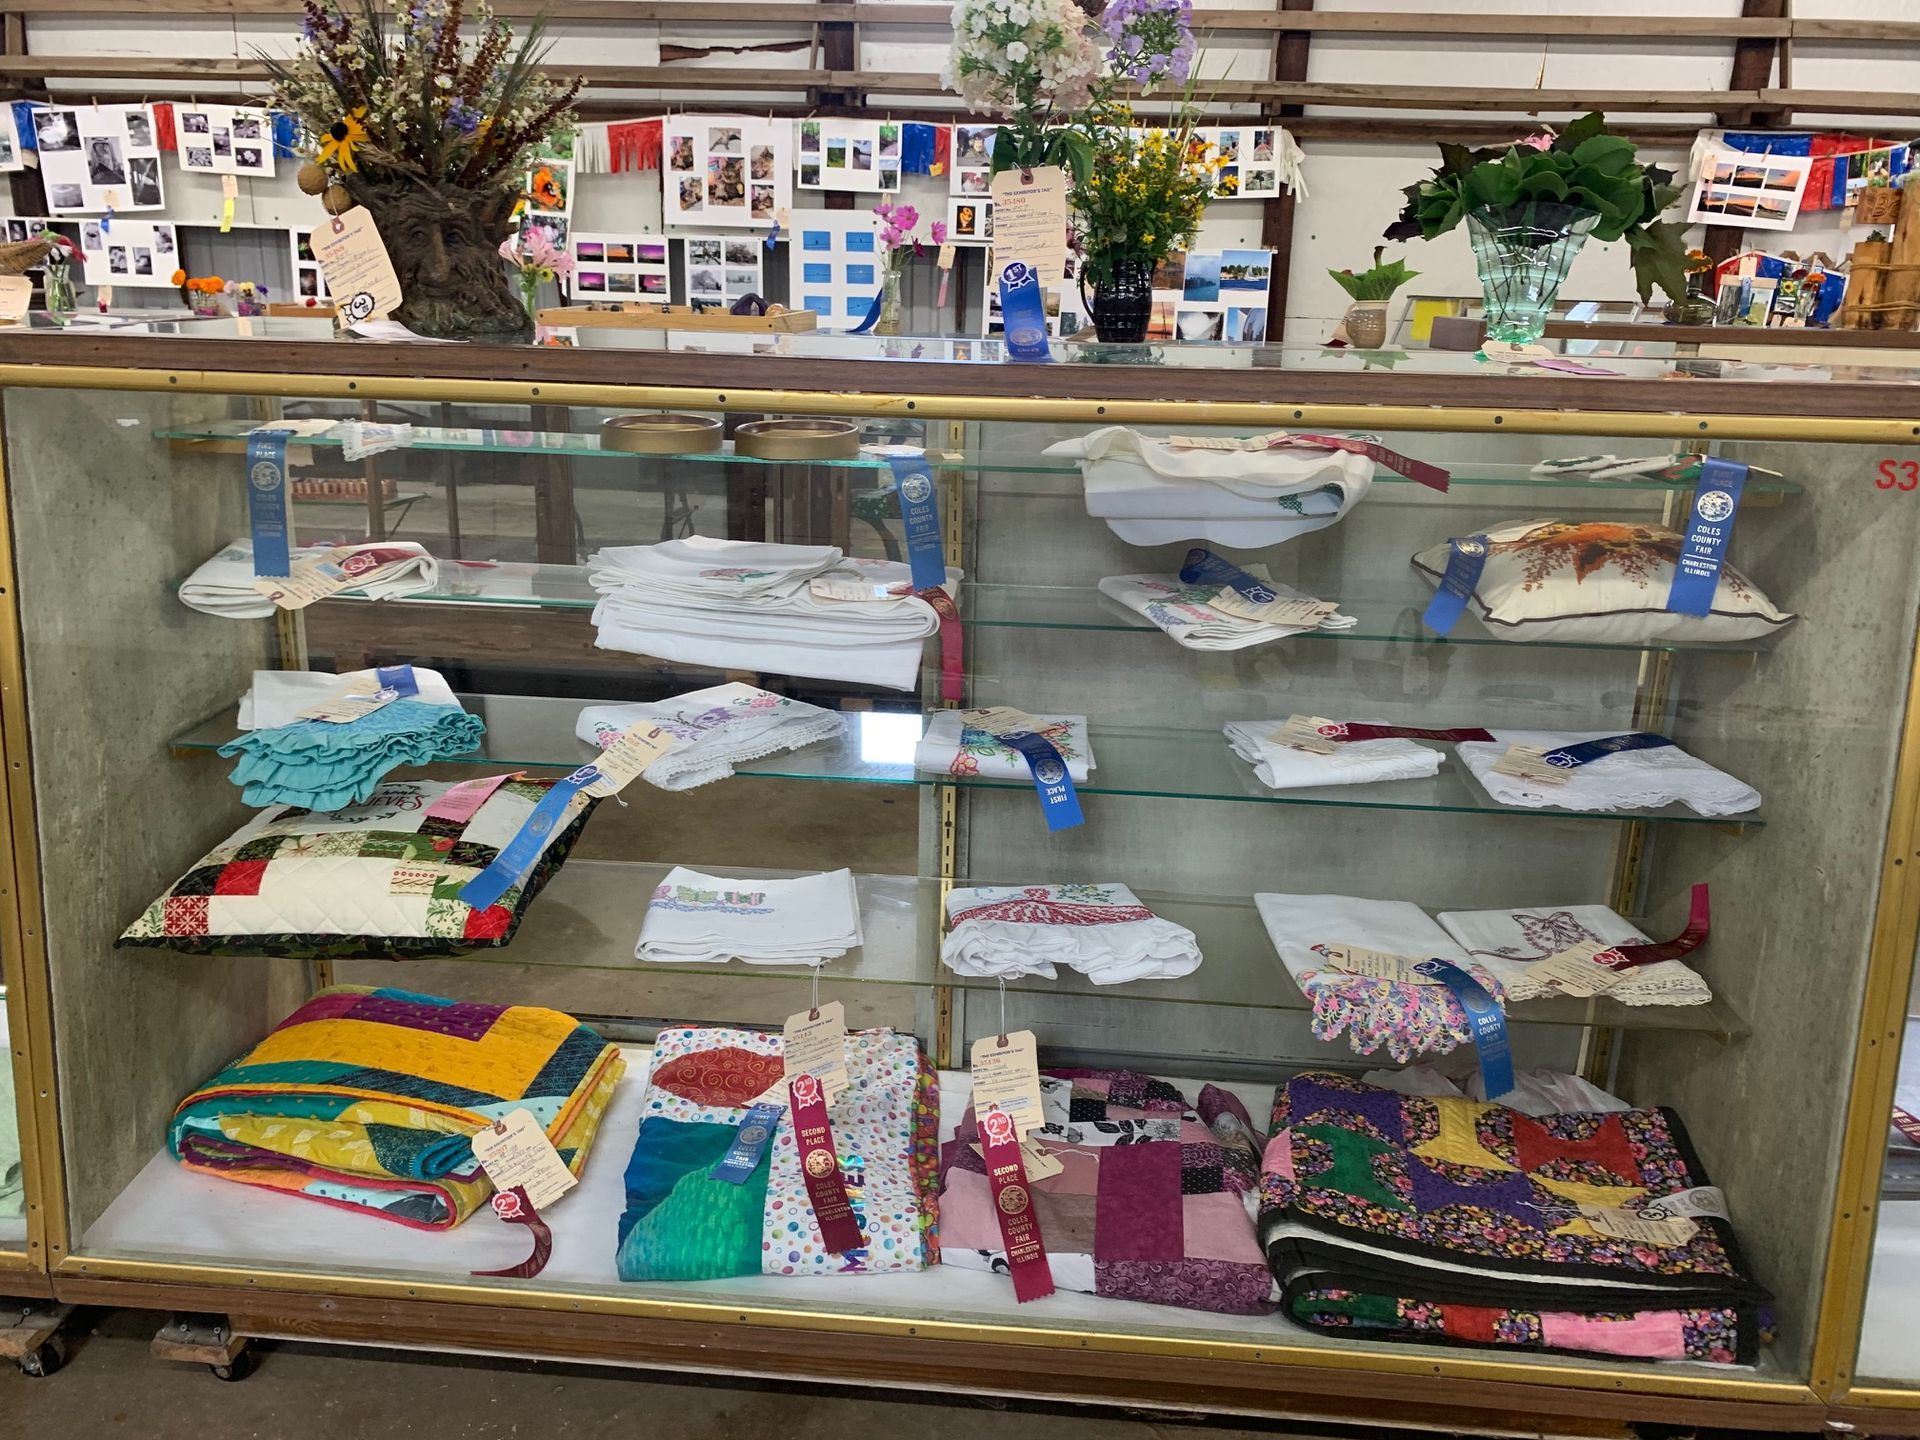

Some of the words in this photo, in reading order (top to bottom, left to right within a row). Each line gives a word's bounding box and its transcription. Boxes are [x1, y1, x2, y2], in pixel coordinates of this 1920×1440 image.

[1006, 264, 1023, 281] 1ST
[1875, 459, 1920, 491] S3
[1696, 525, 1721, 536] COLES
[1691, 534, 1722, 547] COUNTY
[1695, 545, 1713, 555] FAIR
[1682, 559, 1718, 571] CHARLESTON
[1684, 567, 1711, 578] ILLINOIS
[1046, 785, 1066, 796] PLACE
[1050, 794, 1068, 804] FIRST
[1478, 1014, 1497, 1026] COLES
[1479, 1023, 1501, 1036] COUNTY
[801, 1126, 826, 1138] SECOND
[806, 1136, 825, 1146] PLACE
[993, 1163, 1019, 1177] SECOND
[998, 1174, 1019, 1185] PLACE
[815, 1180, 836, 1191] COLES
[815, 1188, 840, 1198] COUNTY
[1008, 1214, 1028, 1226] COLES
[1007, 1222, 1033, 1236] COUNTY
[1015, 1234, 1031, 1244] FAIR
